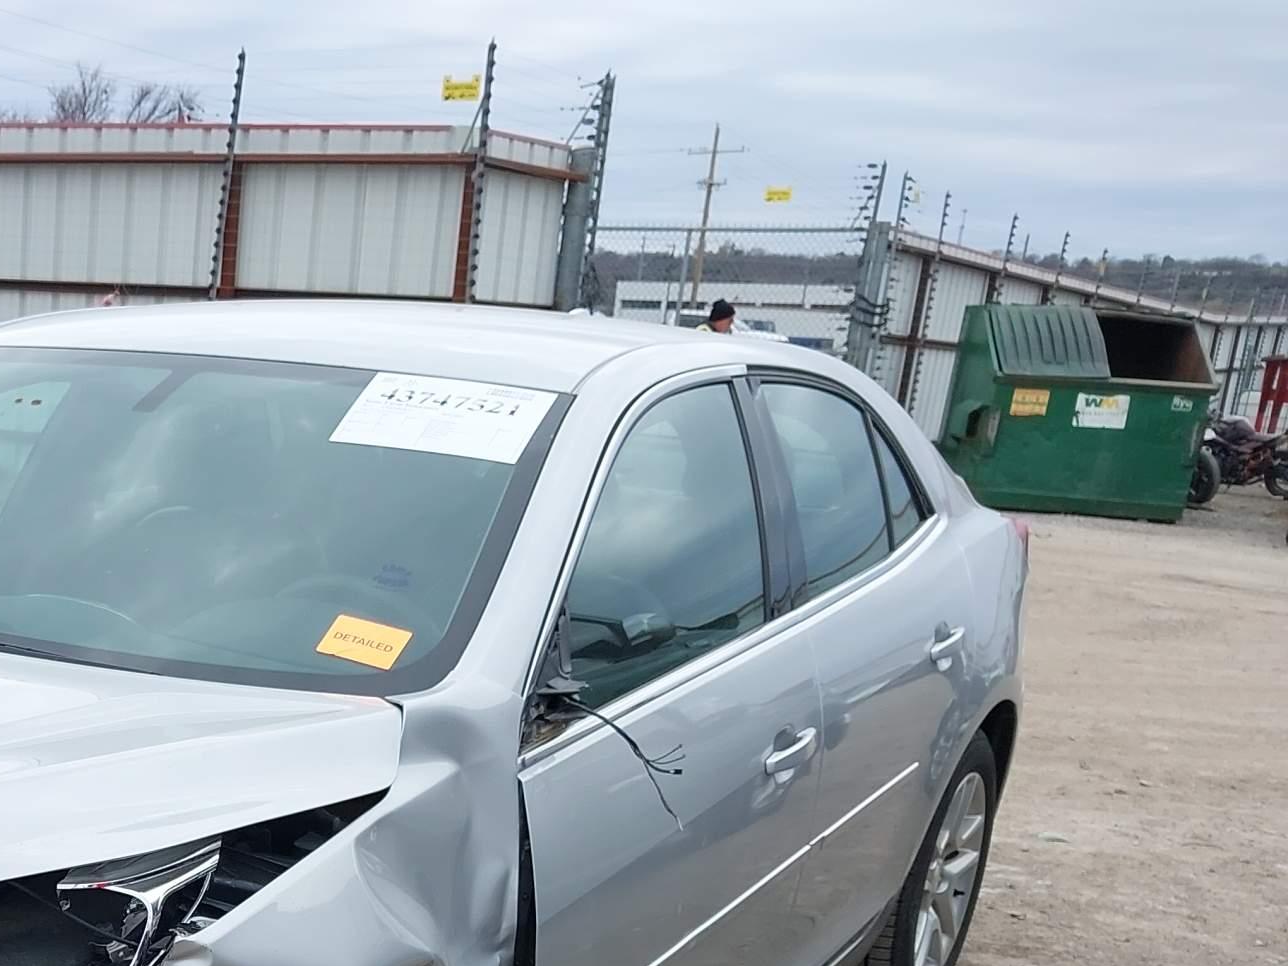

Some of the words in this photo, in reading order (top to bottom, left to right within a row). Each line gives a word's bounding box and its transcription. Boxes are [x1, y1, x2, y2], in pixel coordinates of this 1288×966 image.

[380, 388, 520, 416] 43747521
[1085, 397, 1119, 409] WM
[332, 631, 394, 653] DETAILED
